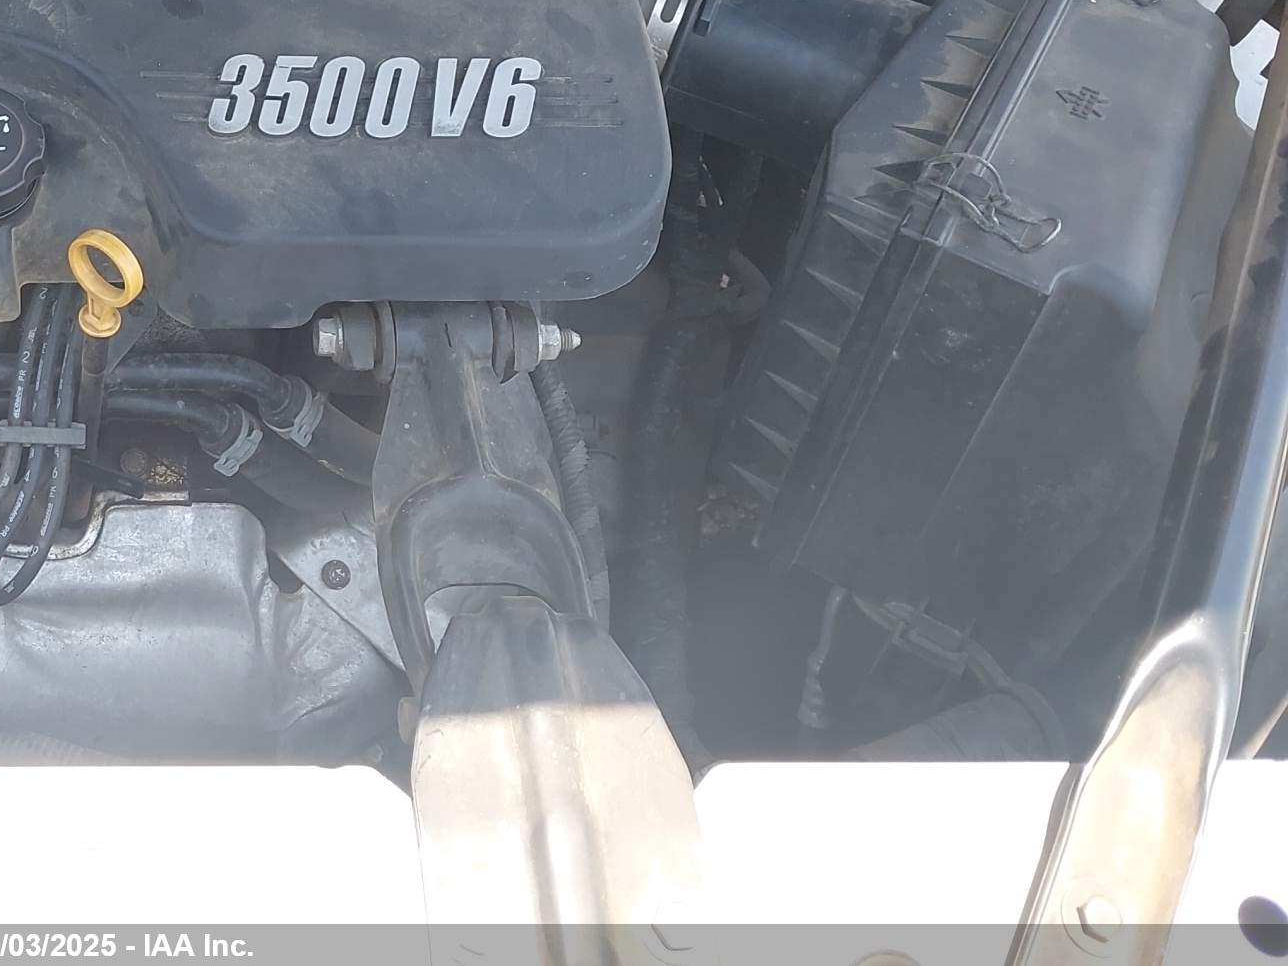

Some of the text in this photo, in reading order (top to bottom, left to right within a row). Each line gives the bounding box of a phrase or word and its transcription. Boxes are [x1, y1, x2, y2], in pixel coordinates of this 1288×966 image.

[208, 54, 543, 138] 3500 V6
[21, 350, 31, 364] 2
[17, 369, 27, 382] PR
